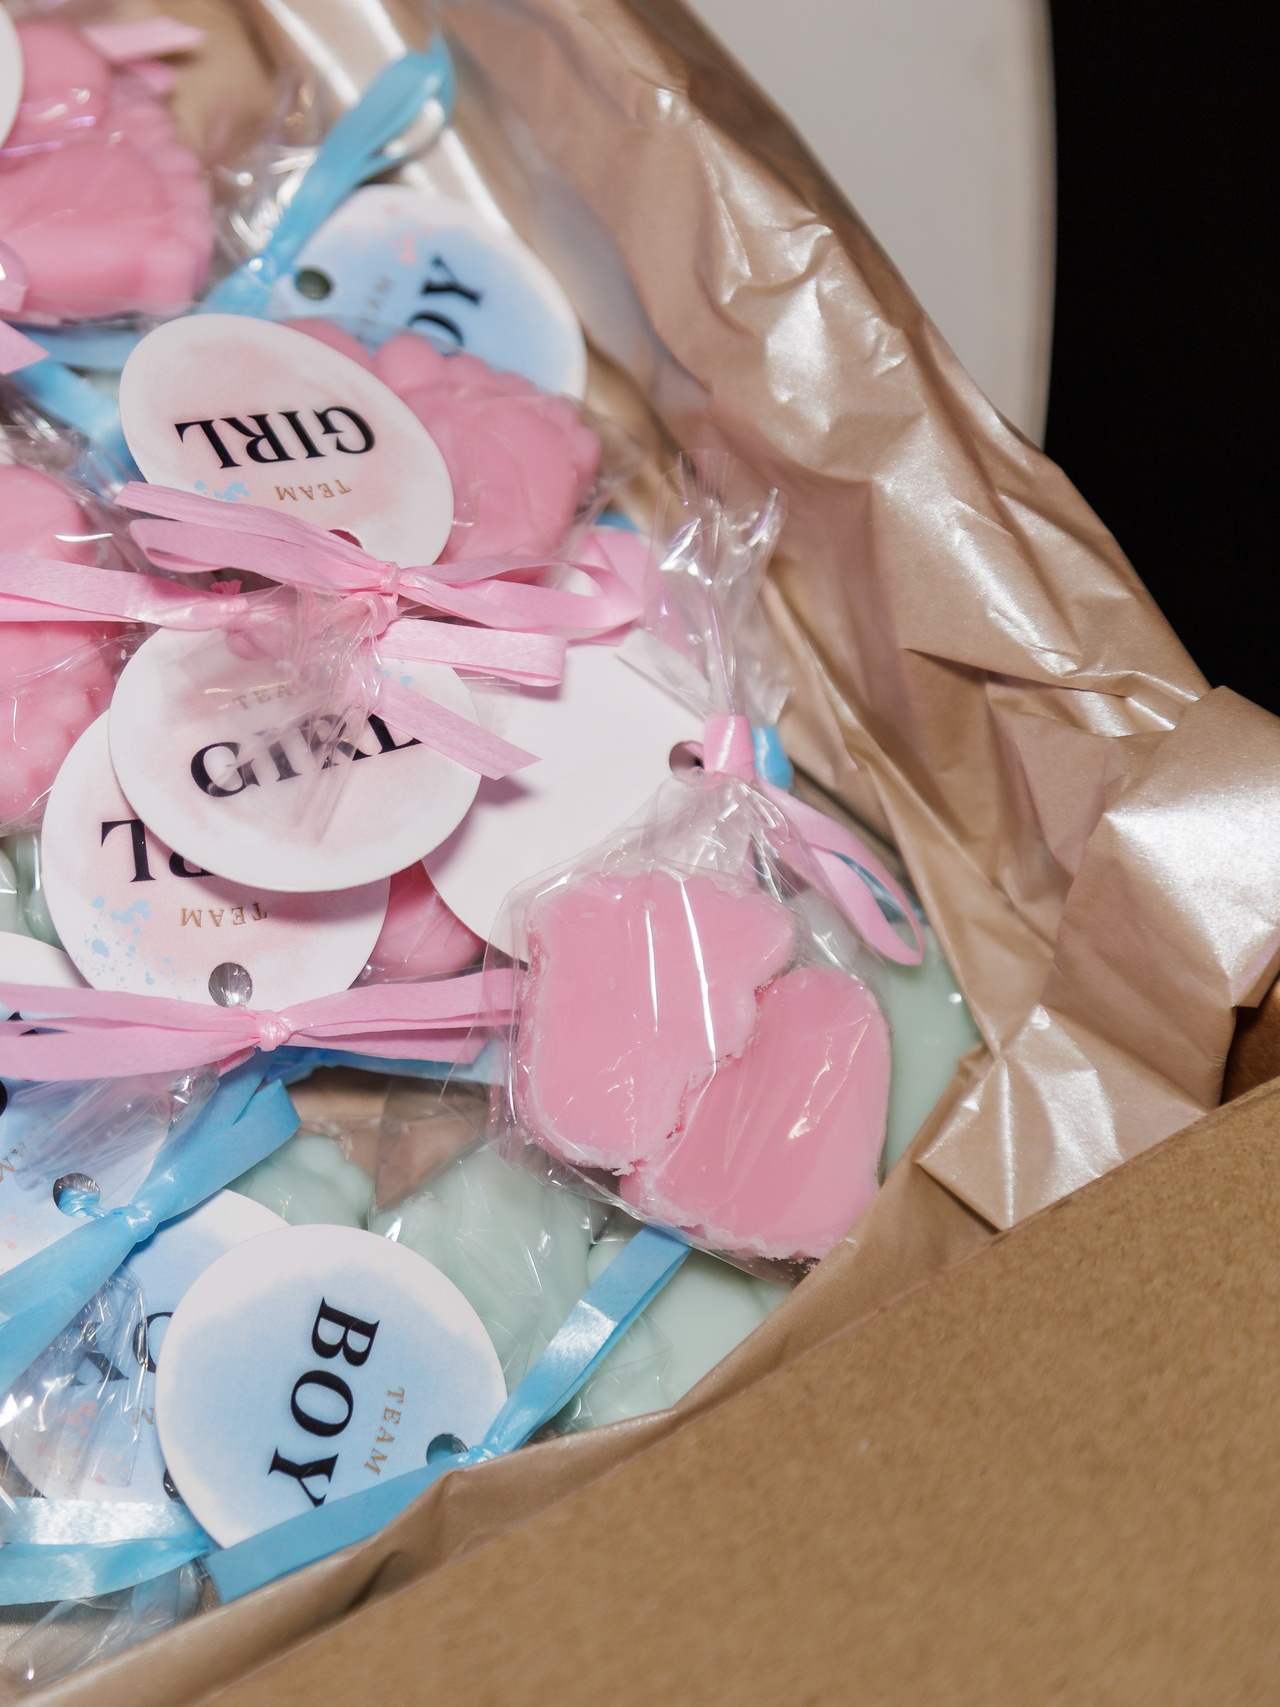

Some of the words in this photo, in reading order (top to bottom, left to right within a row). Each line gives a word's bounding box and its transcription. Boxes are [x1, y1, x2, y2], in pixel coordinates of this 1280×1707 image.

[407, 252, 484, 359] OY
[174, 405, 376, 470] GIRL
[273, 478, 352, 502] TEAM
[180, 901, 269, 928] TEAM
[267, 1296, 381, 1508] BOY
[364, 1387, 406, 1476] TEAM
